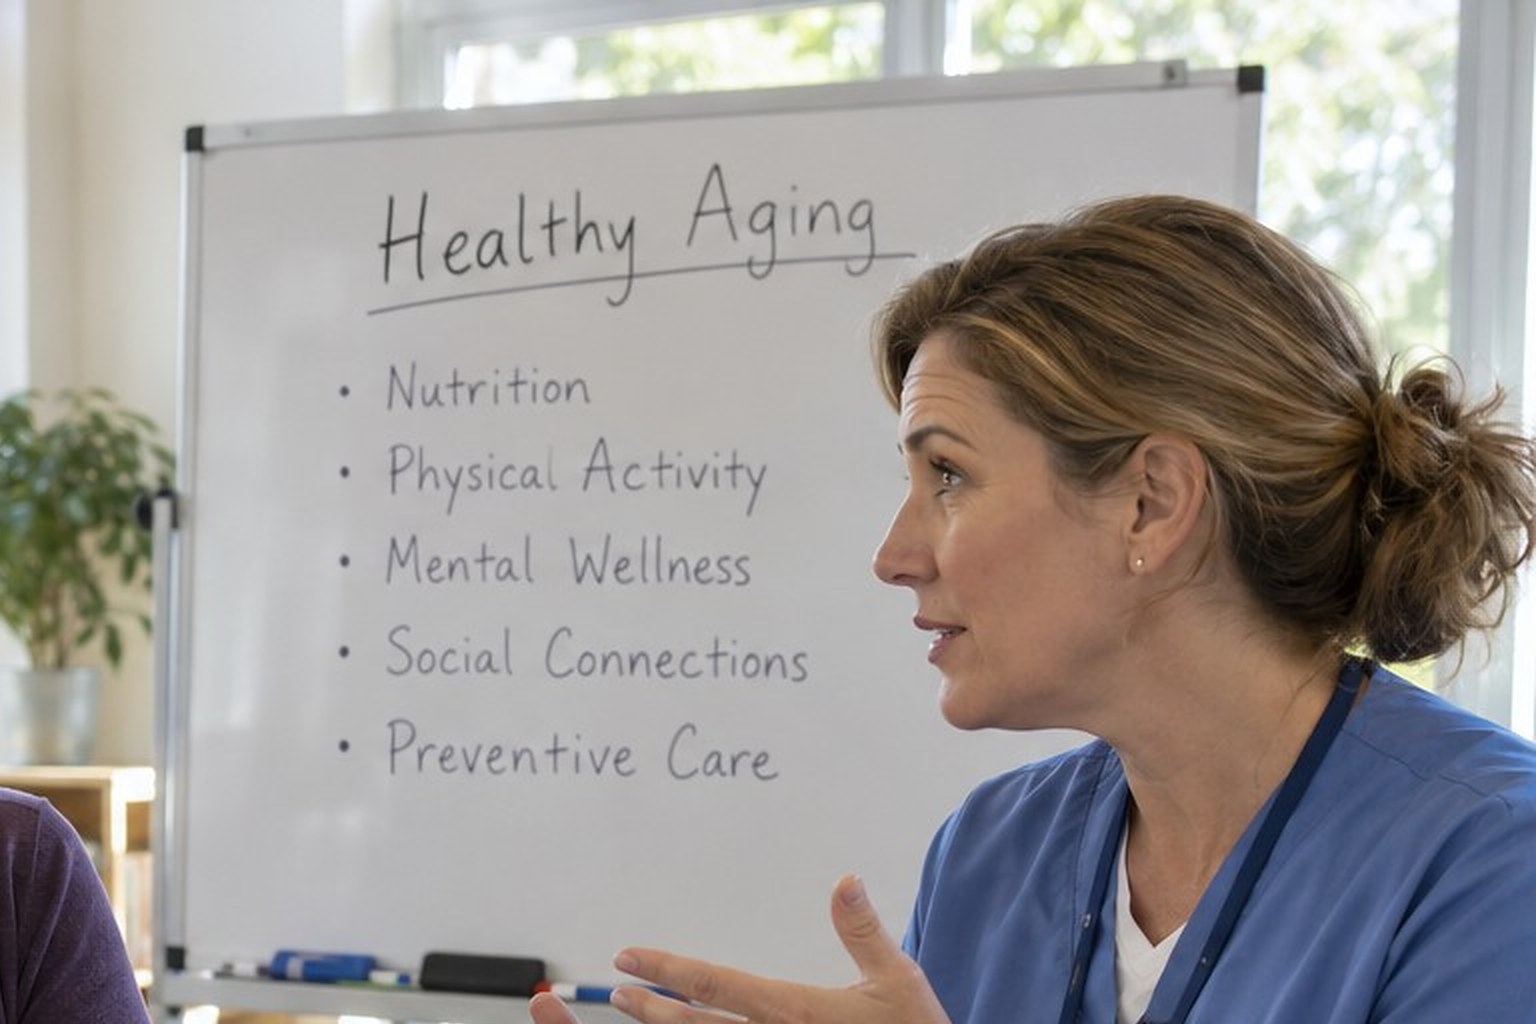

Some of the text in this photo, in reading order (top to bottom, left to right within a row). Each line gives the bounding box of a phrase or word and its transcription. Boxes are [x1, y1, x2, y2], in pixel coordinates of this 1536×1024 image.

[378, 162, 877, 307] Healthy Aging
[386, 361, 591, 411] Nutrition
[388, 436, 768, 518] Physical Activity
[385, 533, 752, 587] Mental Wellness
[386, 623, 809, 683] Social Connections
[386, 717, 780, 782] Preventive Care
